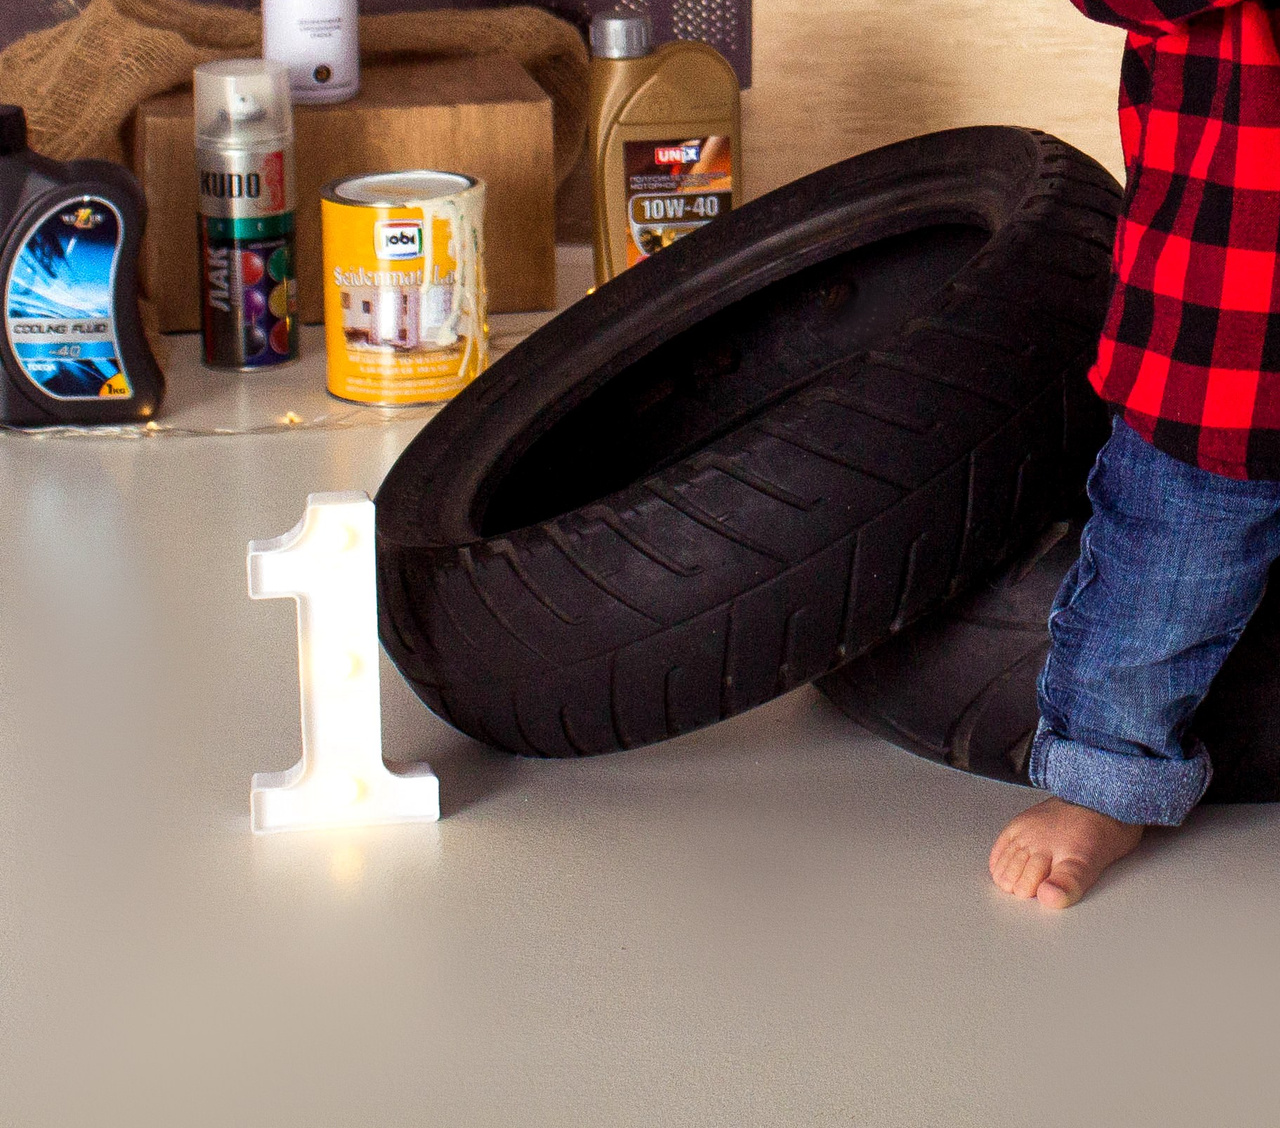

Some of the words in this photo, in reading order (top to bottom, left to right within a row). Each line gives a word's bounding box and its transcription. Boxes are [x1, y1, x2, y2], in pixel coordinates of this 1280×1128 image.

[200, 171, 261, 199] KUDO
[640, 196, 719, 220] 10W-40
[207, 247, 231, 312] ЛАК
[49, 345, 81, 358] -40
[247, 489, 440, 835] 1
